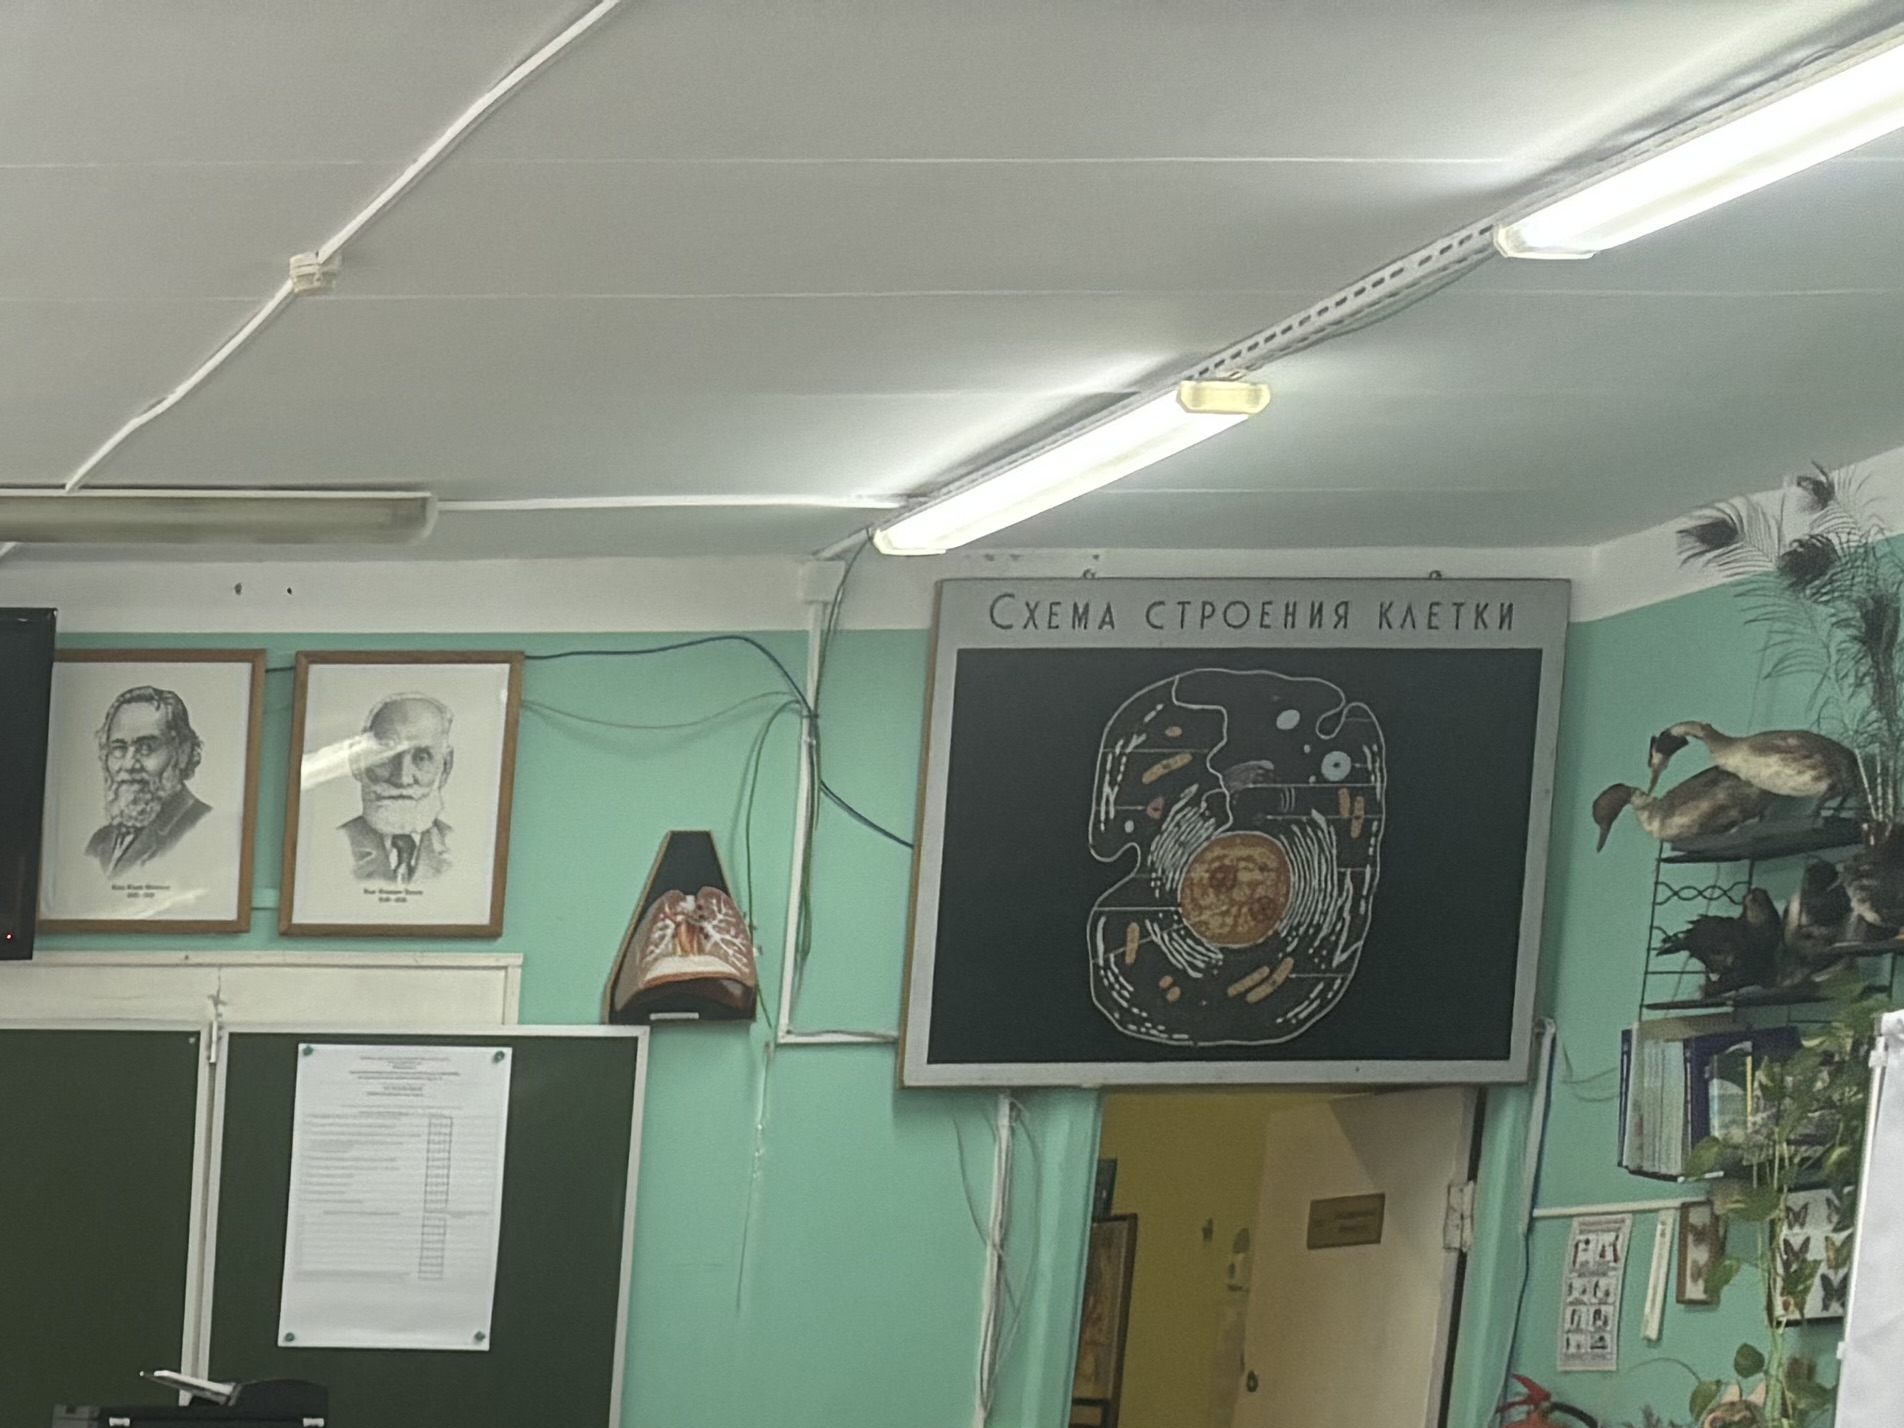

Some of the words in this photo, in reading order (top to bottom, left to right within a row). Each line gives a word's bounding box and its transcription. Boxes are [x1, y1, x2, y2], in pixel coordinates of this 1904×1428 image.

[989, 593, 1116, 630] СХЕМА
[1144, 600, 1350, 630] СТРОЕНИЯ
[1378, 601, 1515, 631] КЛЕТКИ
